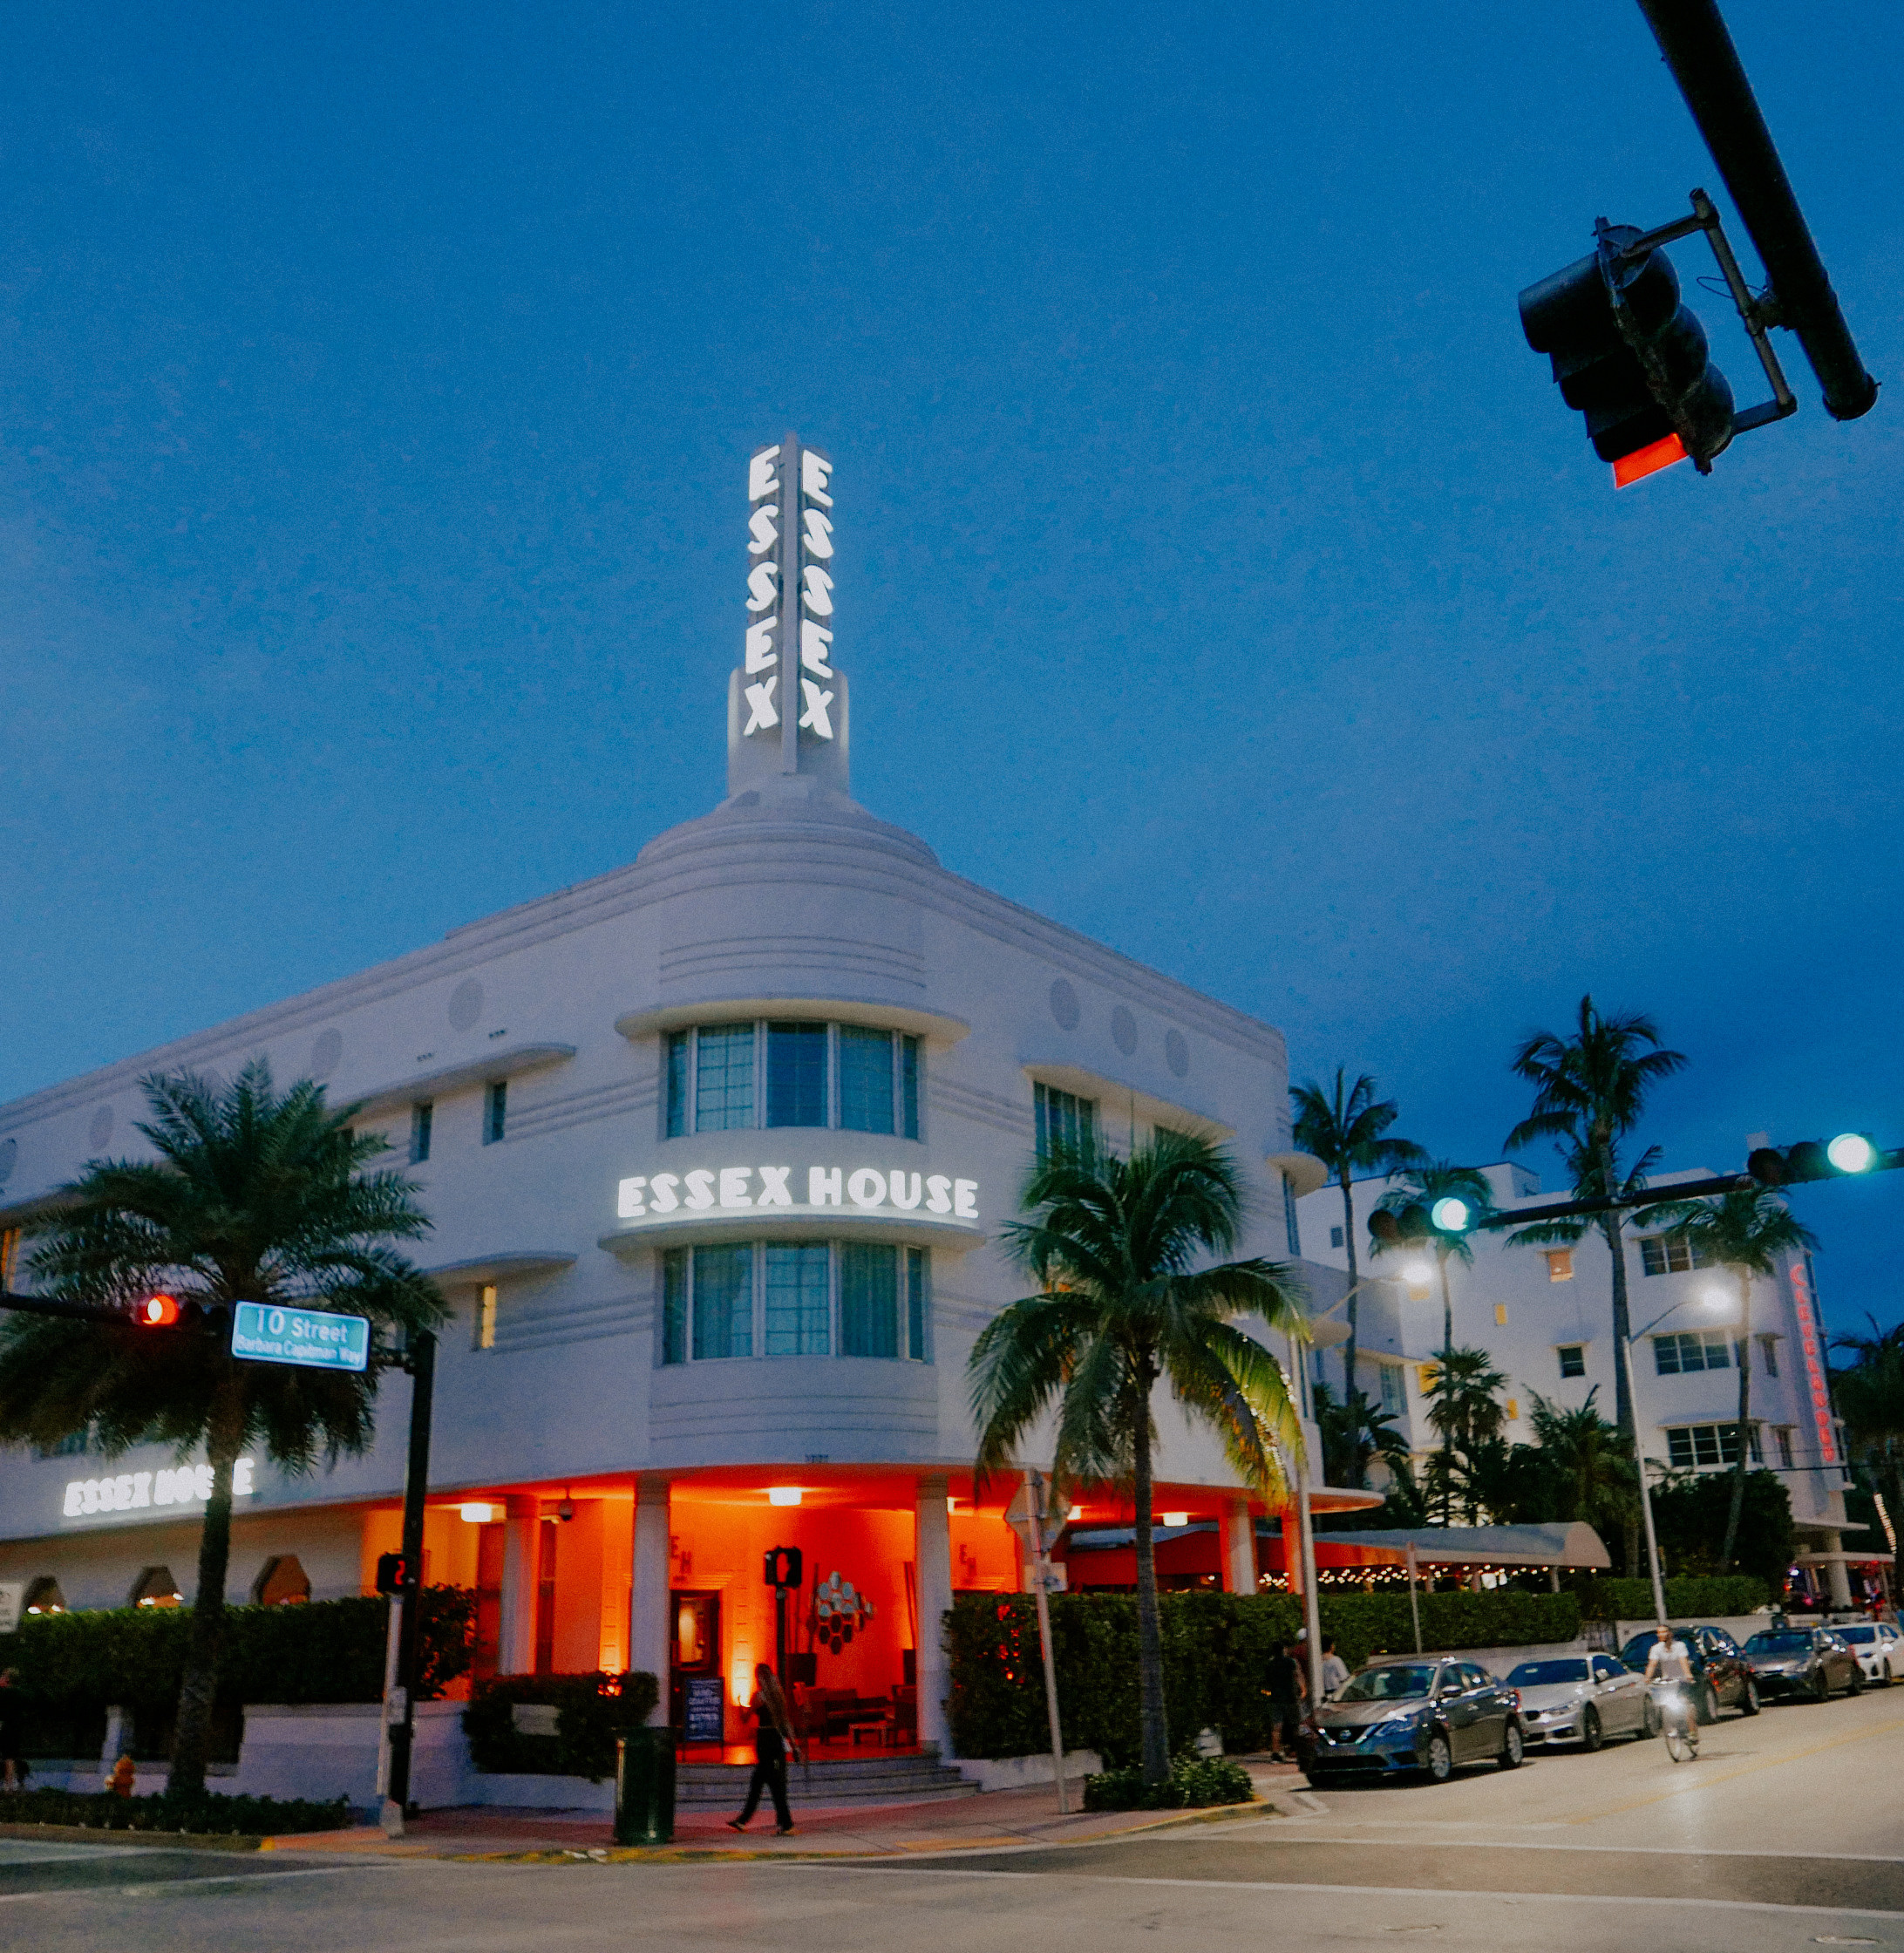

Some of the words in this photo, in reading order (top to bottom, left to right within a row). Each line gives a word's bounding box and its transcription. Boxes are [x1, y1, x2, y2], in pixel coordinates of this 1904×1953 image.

[744, 445, 782, 737] ESSEX
[798, 448, 834, 740] ESSEX
[617, 1166, 792, 1218] ESSEX
[808, 1166, 979, 1219] HOUSE
[256, 1308, 285, 1336] 10
[290, 1317, 348, 1344] Street
[63, 1471, 152, 1517] ESSEX
[153, 1458, 255, 1506] HOUE
